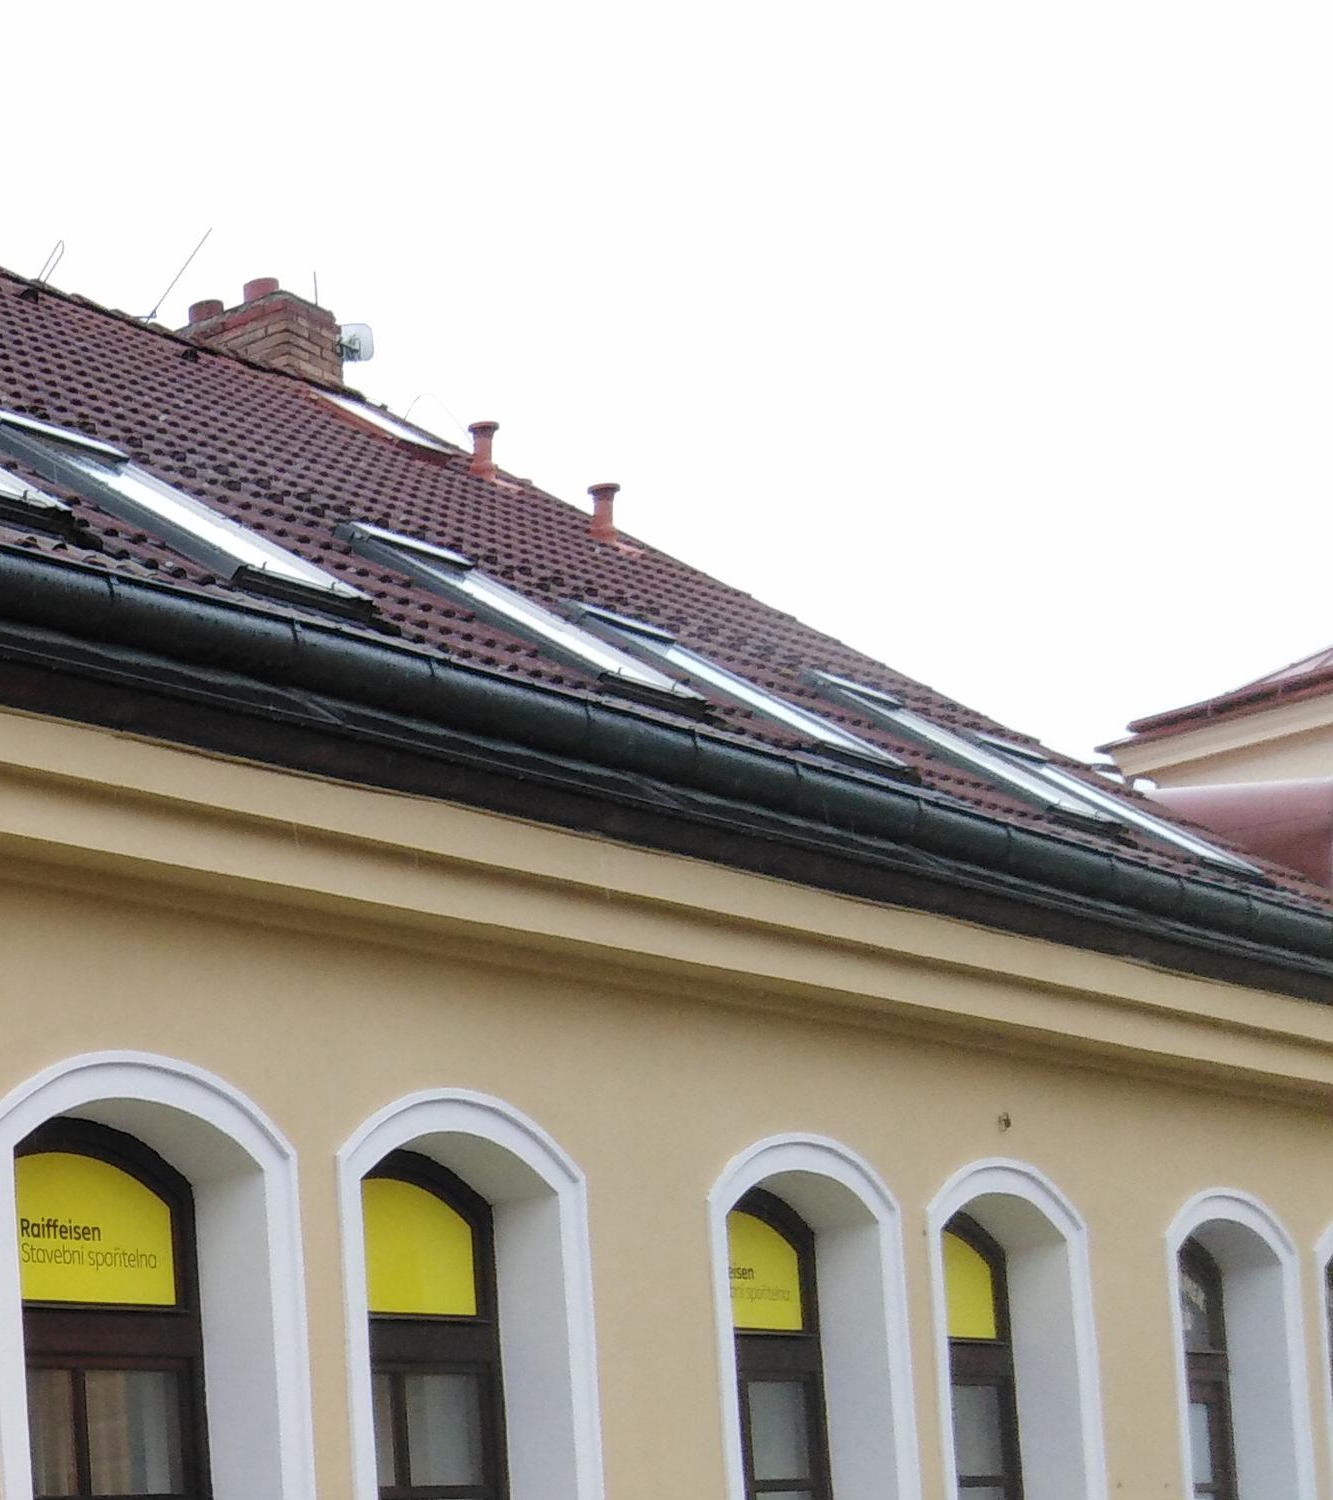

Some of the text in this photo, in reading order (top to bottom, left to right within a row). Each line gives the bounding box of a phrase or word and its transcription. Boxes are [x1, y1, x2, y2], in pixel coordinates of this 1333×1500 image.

[20, 1217, 102, 1241] Raiffeisen
[21, 1242, 157, 1271] Stavební spořitelna
[729, 1262, 754, 1280] eisen
